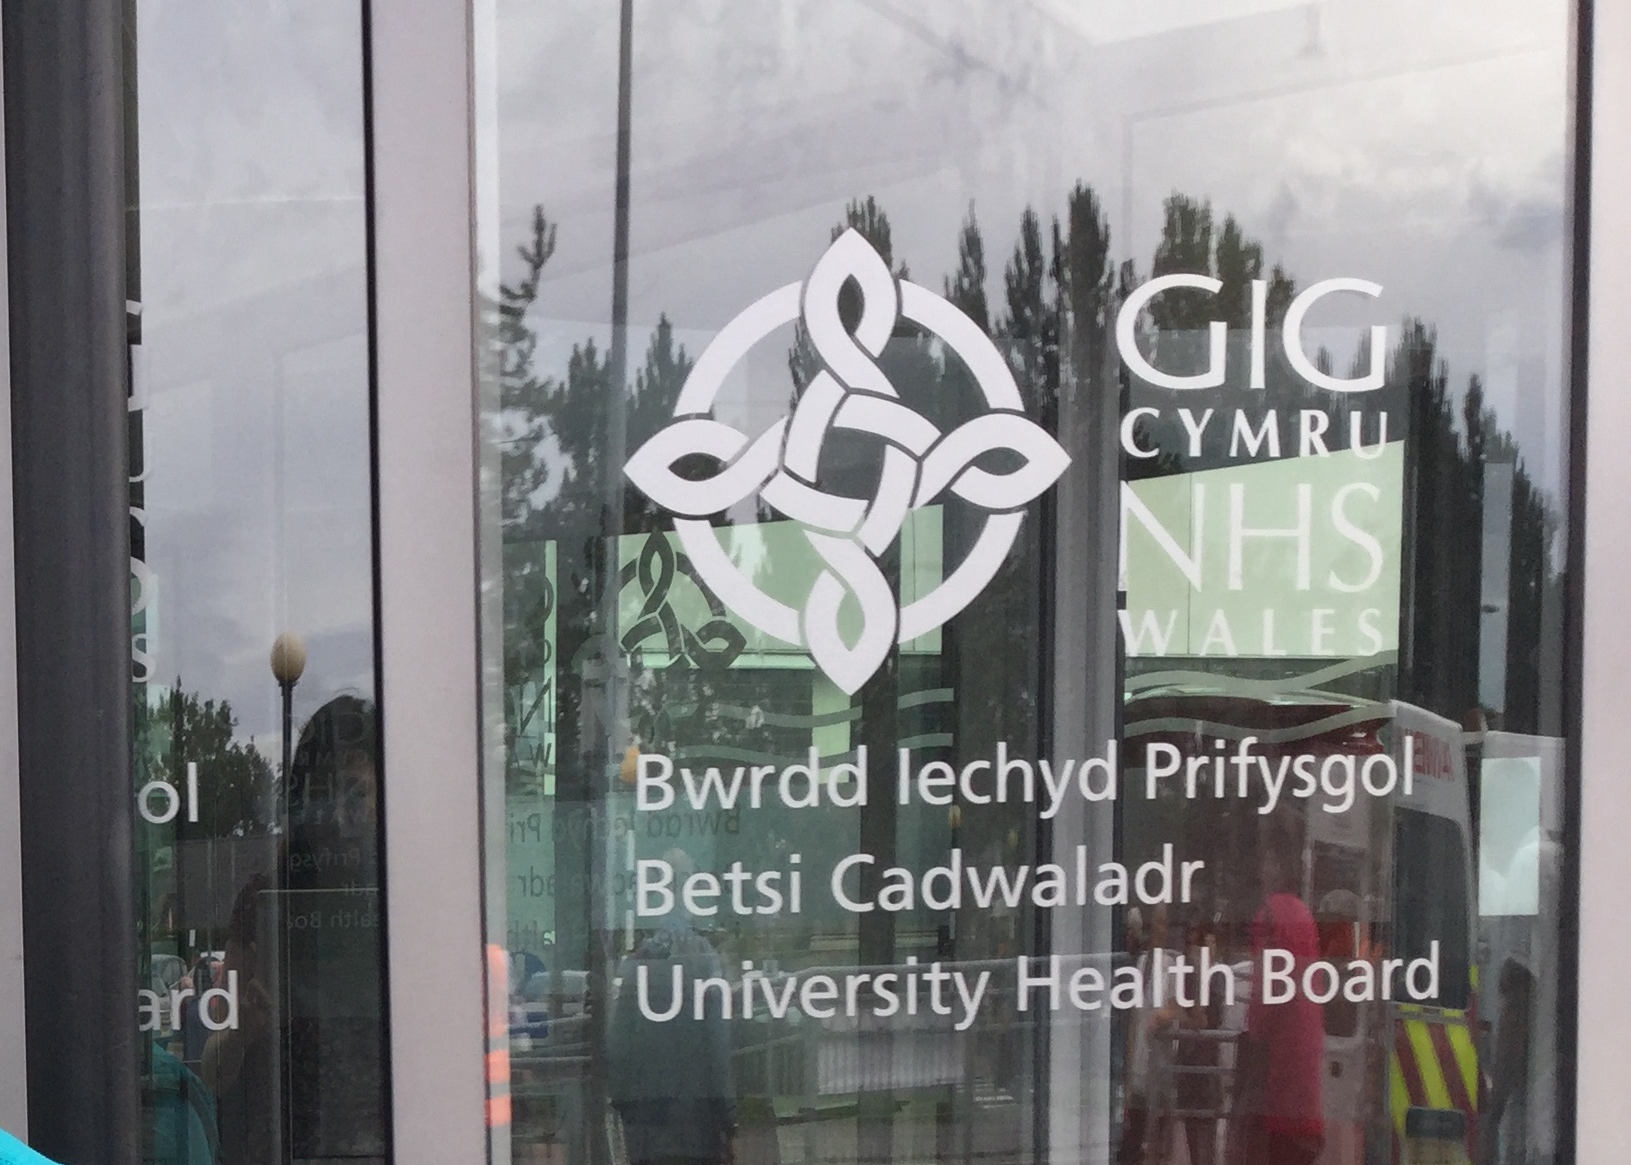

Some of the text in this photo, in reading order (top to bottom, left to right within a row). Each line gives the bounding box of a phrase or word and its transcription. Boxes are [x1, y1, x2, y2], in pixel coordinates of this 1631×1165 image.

[1116, 273, 1387, 392] GIG
[1120, 407, 1387, 459] CYMRU
[1118, 480, 1383, 593] NHS
[1117, 608, 1384, 657] WALES
[636, 745, 868, 810] Bwrdd
[898, 739, 1117, 819] Iechyd
[1145, 735, 1413, 814] Prifysgol
[636, 854, 802, 916] Betsi
[831, 843, 1205, 912] Cadwaladr
[636, 940, 1440, 1031] University Health Board
